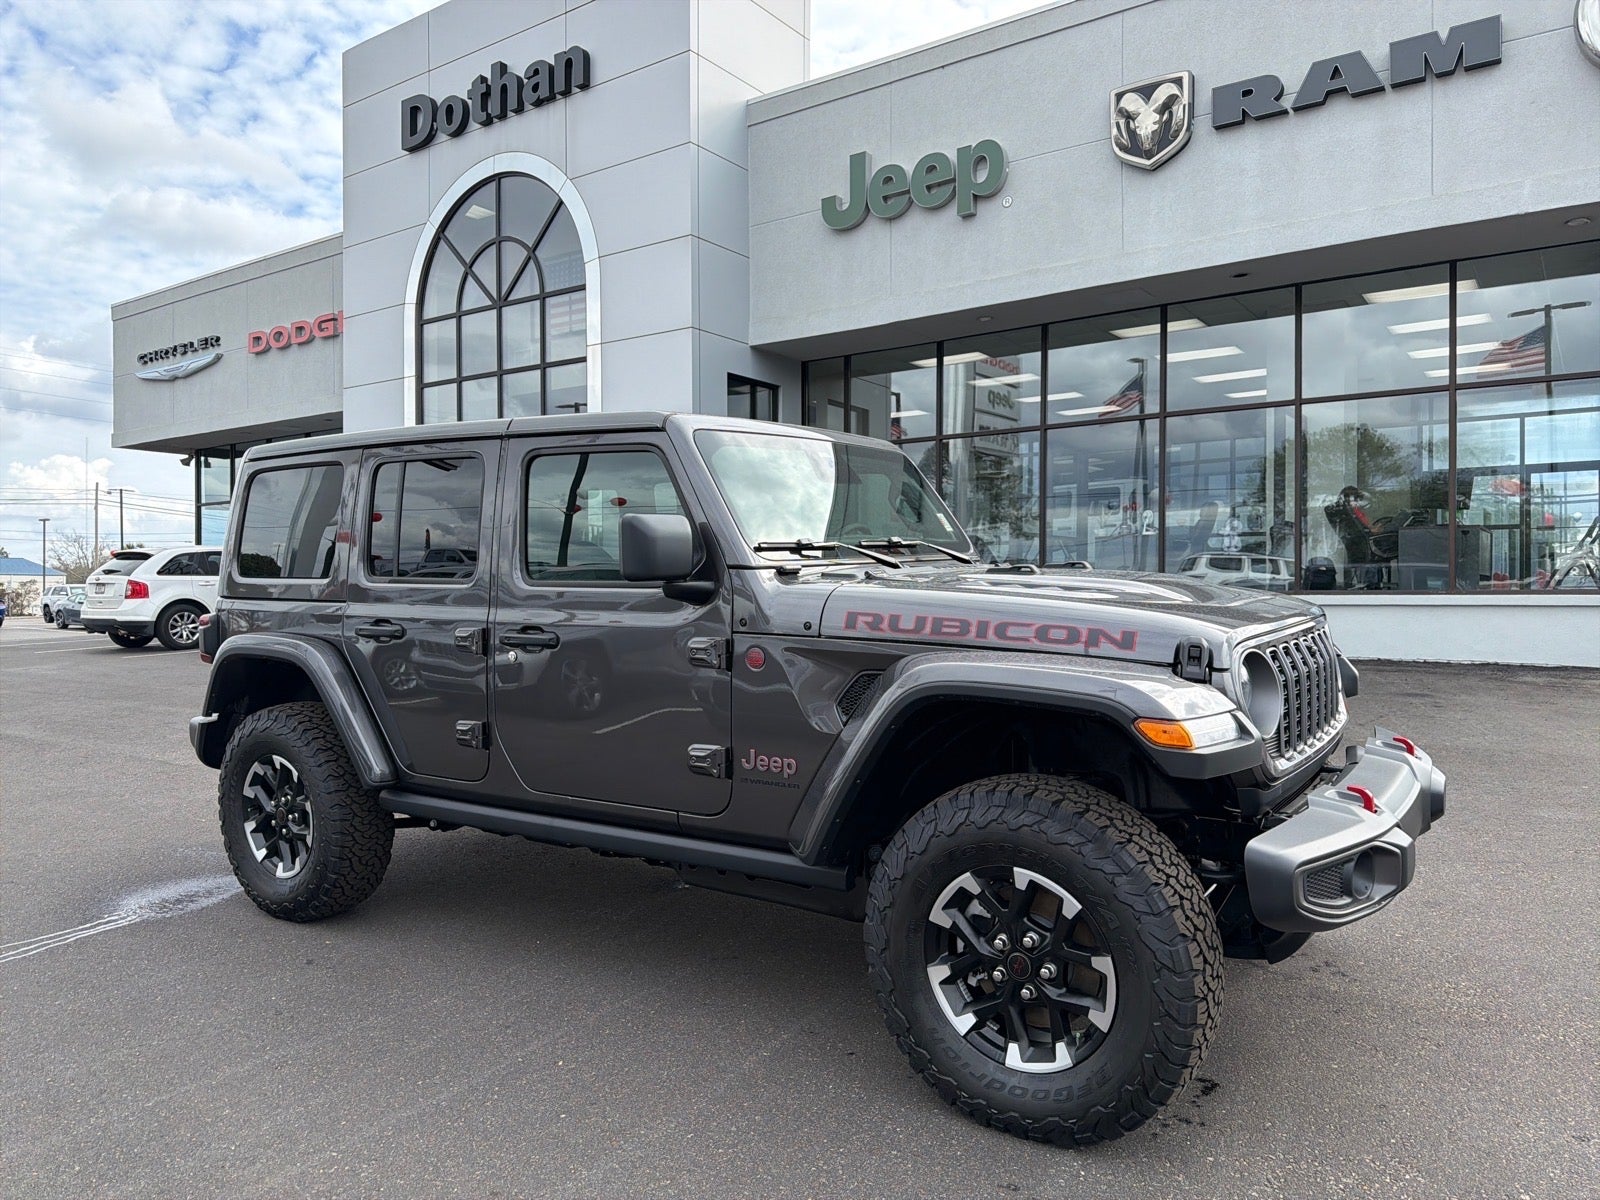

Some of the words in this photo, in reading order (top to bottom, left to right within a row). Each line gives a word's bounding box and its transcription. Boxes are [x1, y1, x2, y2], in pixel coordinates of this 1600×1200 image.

[401, 45, 591, 152] Dothan
[1211, 13, 1502, 130] RAM
[821, 139, 1009, 231] Jeep
[136, 335, 221, 365] CHRYSLER
[842, 610, 1138, 652] RUBICON
[741, 748, 797, 779] Jeep
